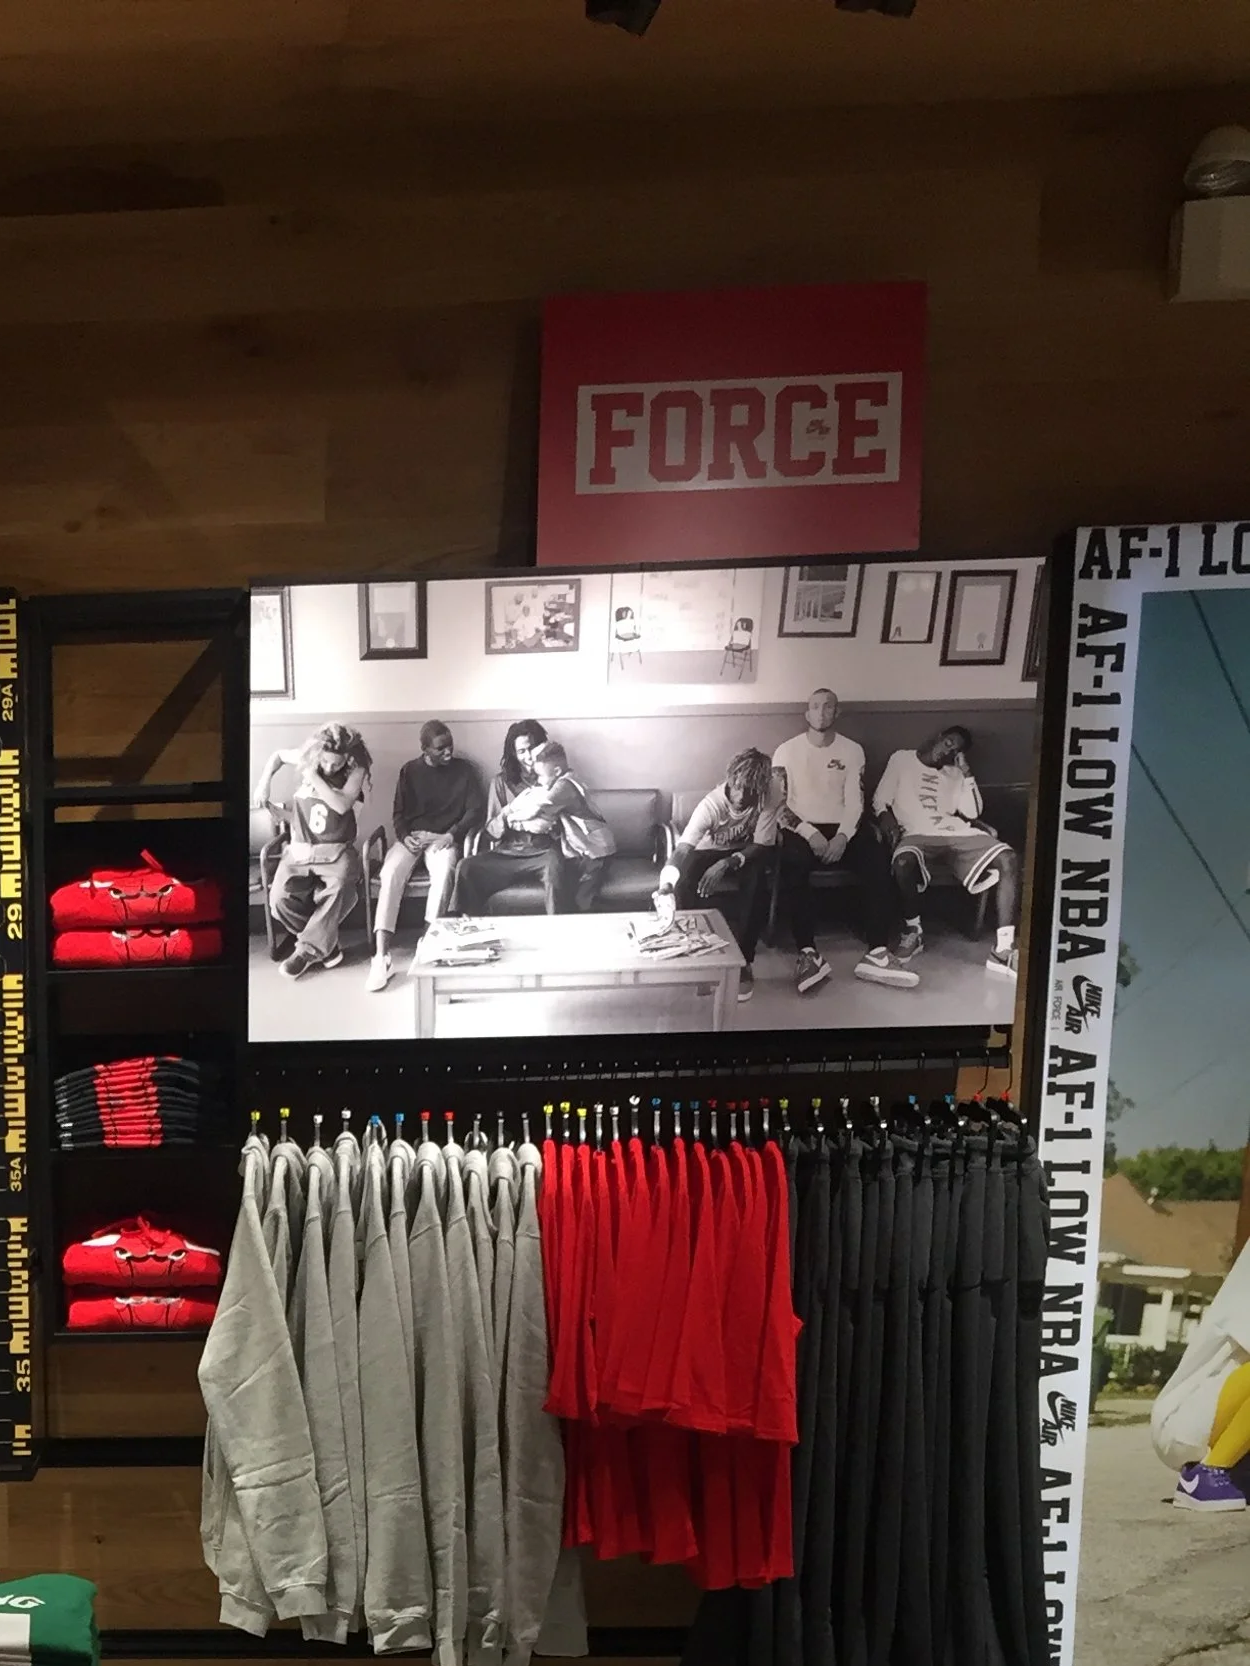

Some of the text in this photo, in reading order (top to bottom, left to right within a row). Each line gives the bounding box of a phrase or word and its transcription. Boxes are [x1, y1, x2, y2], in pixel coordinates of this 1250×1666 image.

[589, 382, 889, 484] FORCE
[1078, 525, 1180, 580] AF-1
[2, 684, 14, 722] 29A
[1057, 603, 1127, 963] AF-1 LOW NBA
[7, 903, 23, 940] 29
[1085, 983, 1103, 1019] NIKE
[1064, 1004, 1084, 1035] AIR
[10, 1157, 22, 1192] 35A
[1039, 1045, 1097, 1378] AF-1 LOW NBA
[16, 1359, 31, 1392] 35
[1040, 1418, 1060, 1446] AIR
[1060, 1398, 1077, 1431] NIKE
